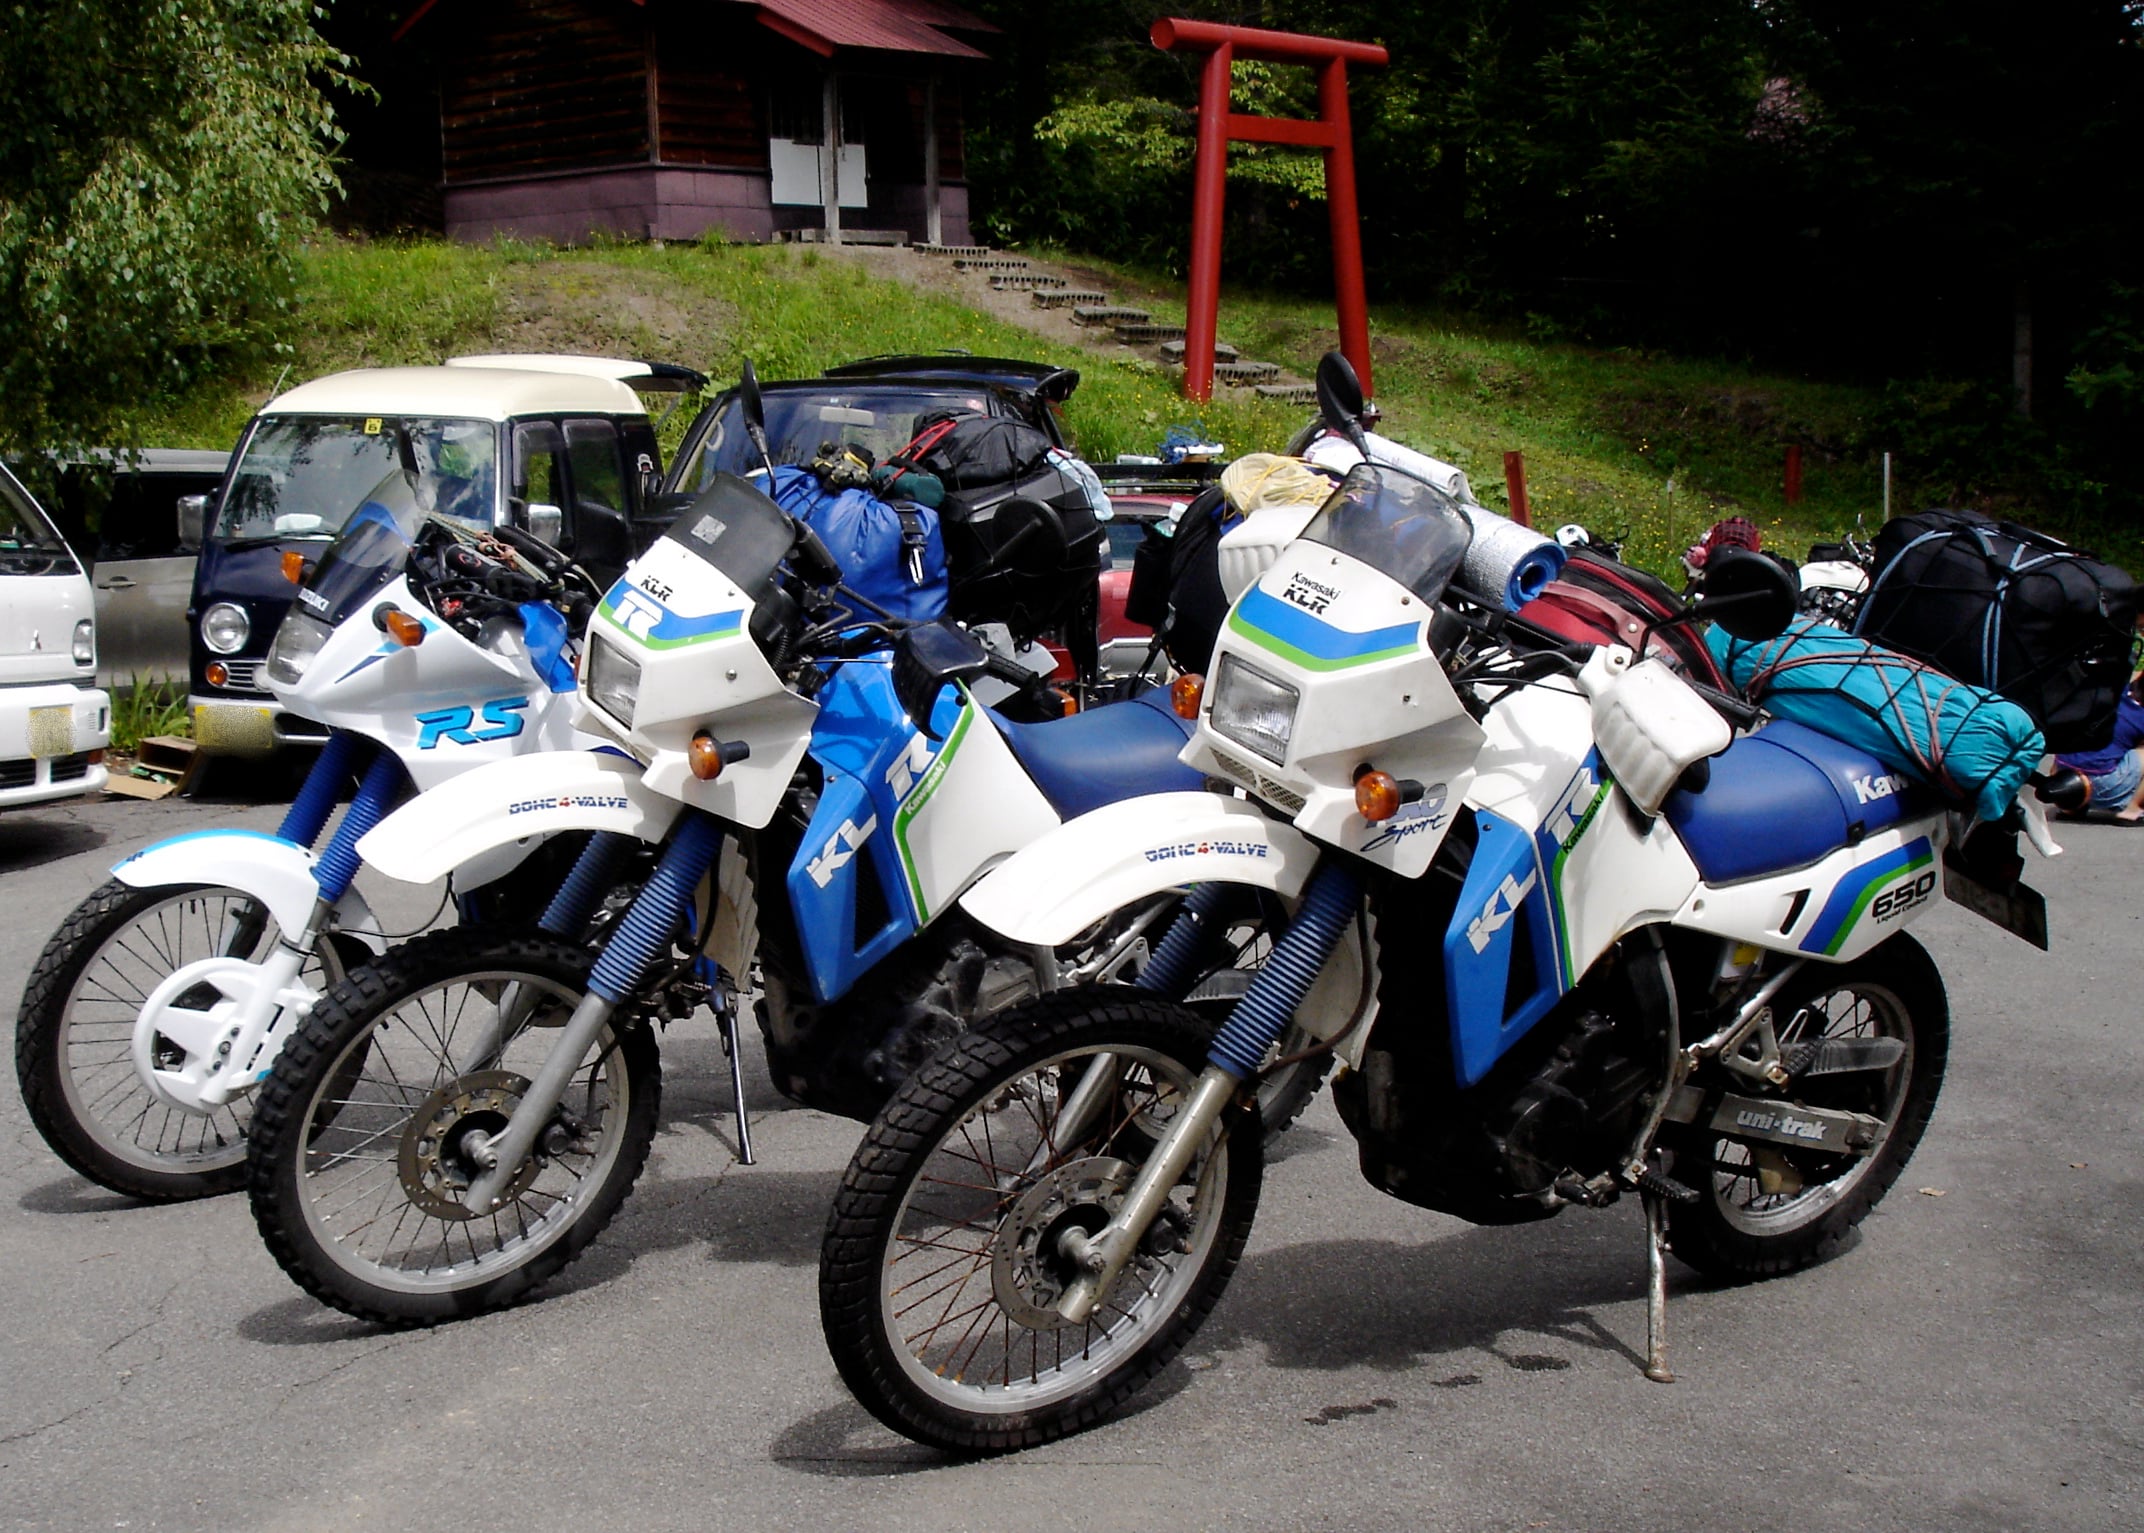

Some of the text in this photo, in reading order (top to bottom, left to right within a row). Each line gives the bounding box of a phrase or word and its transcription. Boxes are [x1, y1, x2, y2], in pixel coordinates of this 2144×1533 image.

[641, 575, 673, 602] KLR
[1283, 583, 1330, 615] KLR
[1291, 571, 1341, 601] Kawasaki
[413, 696, 530, 750] RS
[904, 760, 946, 815] Kawasaki
[1561, 792, 1604, 855] Kawasaki
[1872, 871, 1937, 918] 650
[1736, 1109, 1828, 1141] uni-trak
